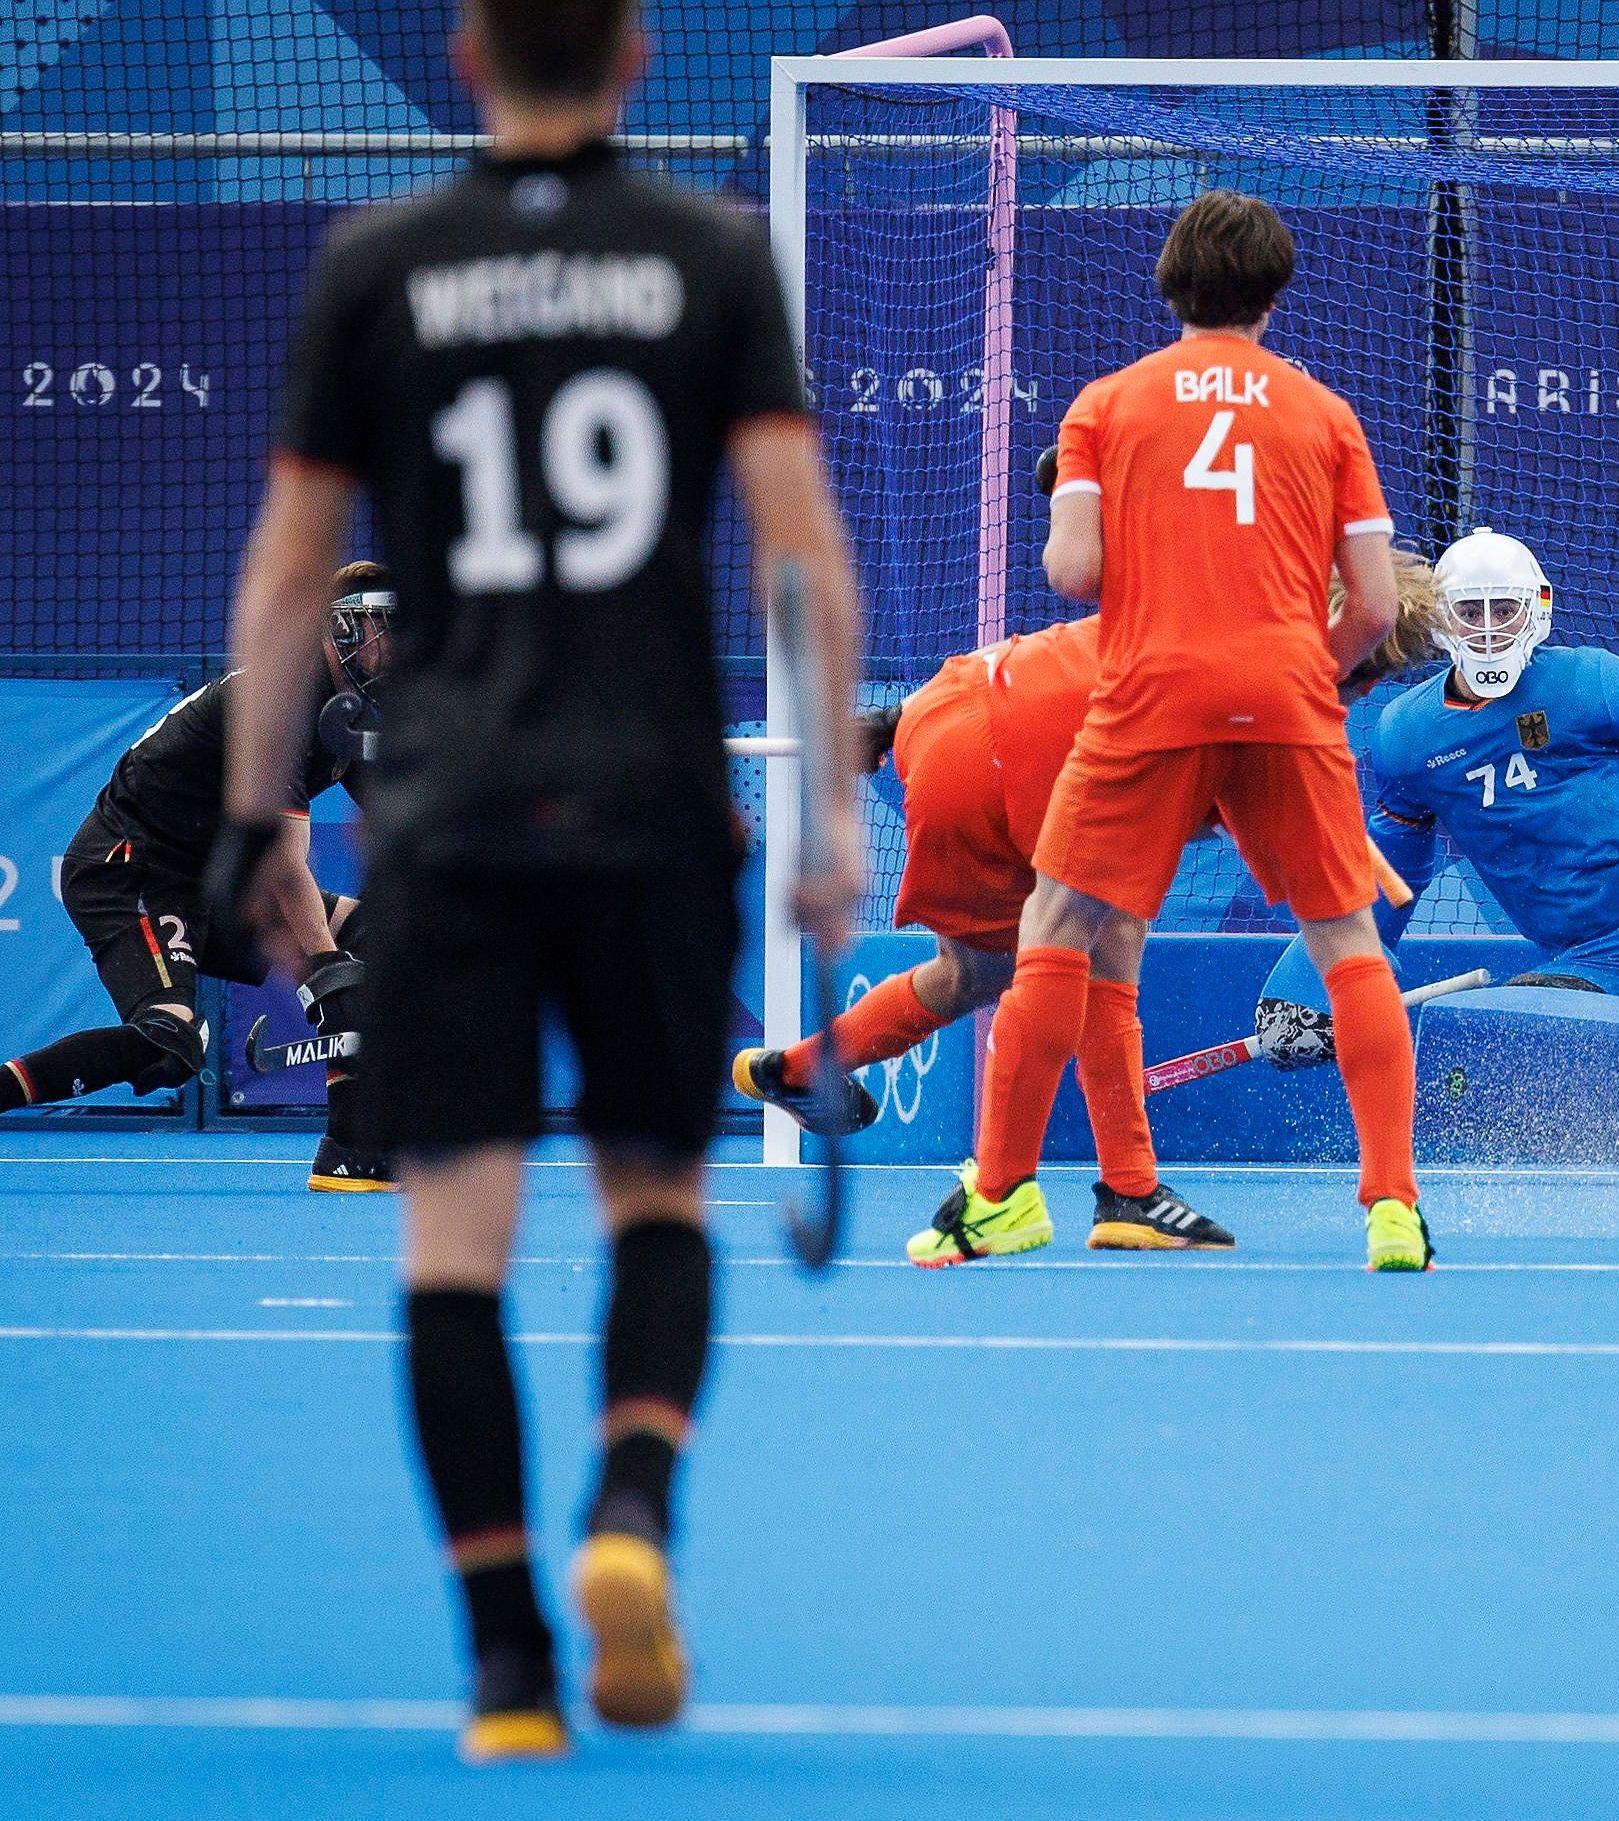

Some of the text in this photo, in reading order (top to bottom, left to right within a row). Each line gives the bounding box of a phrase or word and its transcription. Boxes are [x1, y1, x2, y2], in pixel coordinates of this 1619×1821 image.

[22, 361, 210, 408] 2024
[850, 367, 1038, 413] 2024
[1175, 365, 1270, 408] BALK
[431, 367, 672, 593] 19
[1184, 410, 1255, 526] 4
[1475, 670, 1509, 684] OBO
[1434, 748, 1467, 767] Reece
[1465, 752, 1538, 808] 74
[1192, 1047, 1237, 1075] OBO
